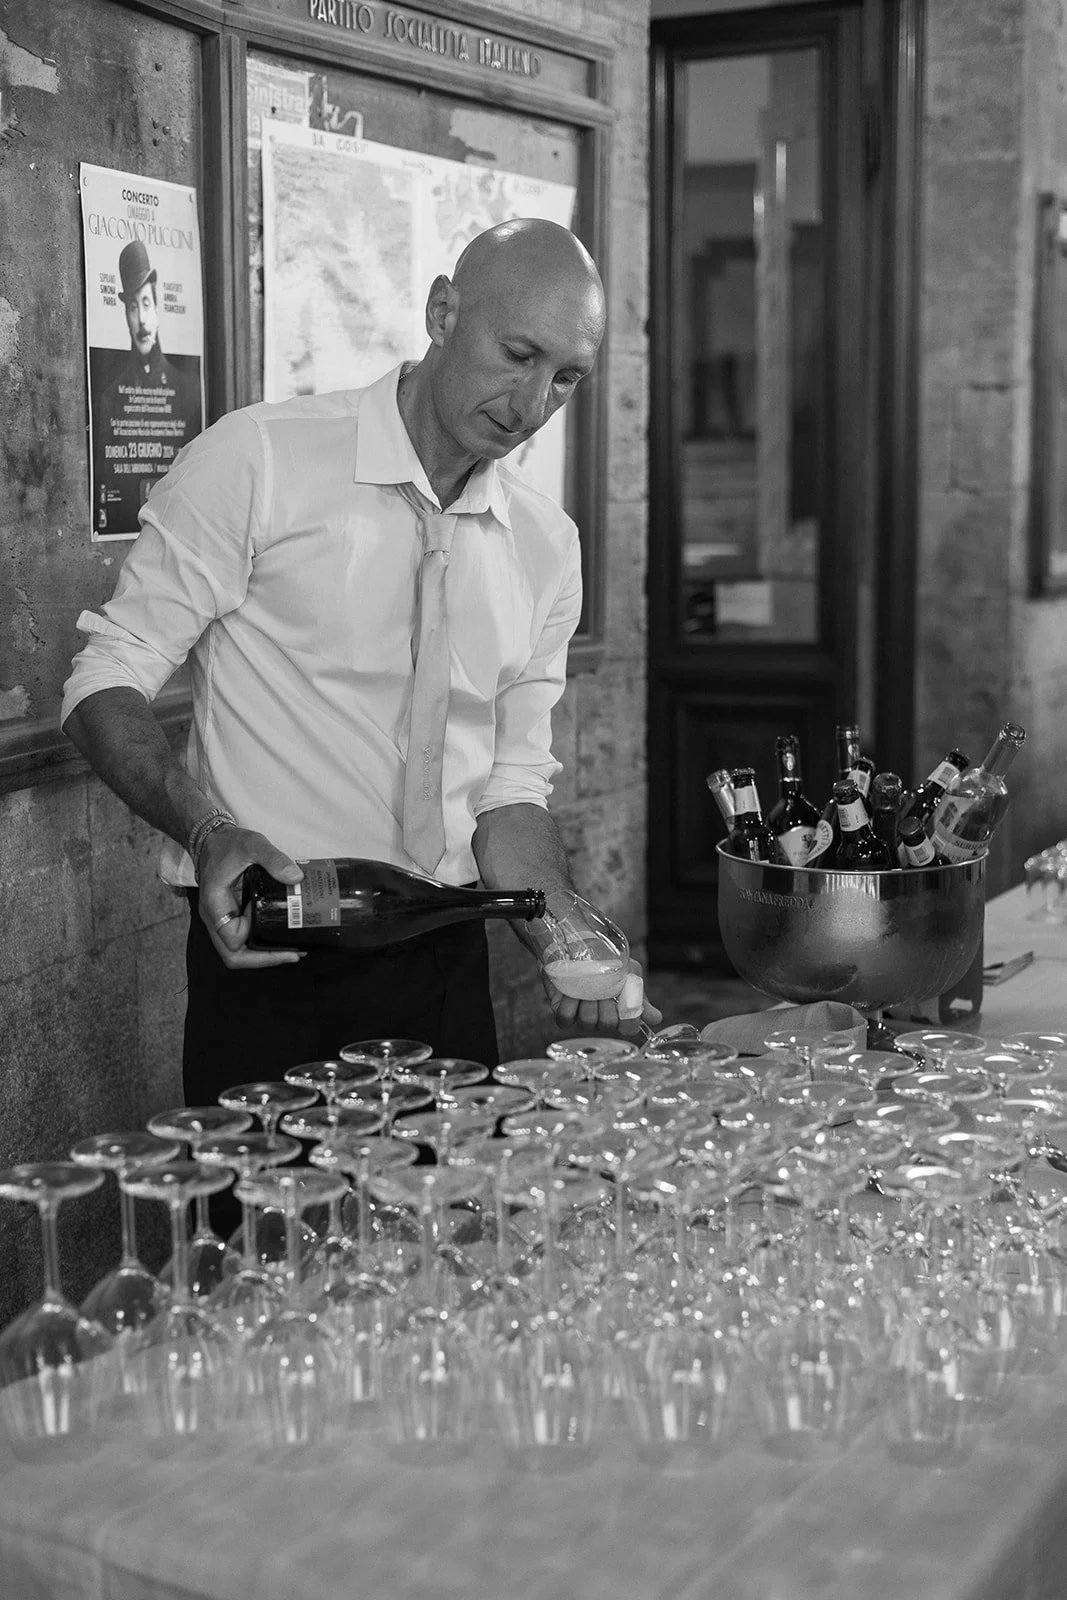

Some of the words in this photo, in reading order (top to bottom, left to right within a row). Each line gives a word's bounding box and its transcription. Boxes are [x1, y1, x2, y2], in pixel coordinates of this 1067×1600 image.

[309, 0, 374, 34] PARTITO
[383, 11, 470, 61] SOCIALISTA
[479, 37, 543, 78] ITALIANO
[122, 189, 159, 206] CONCERTO
[88, 213, 146, 242] GIACOMO
[148, 225, 193, 250] PUCCINI
[128, 442, 137, 459] 23
[137, 442, 162, 459] GIUGNO
